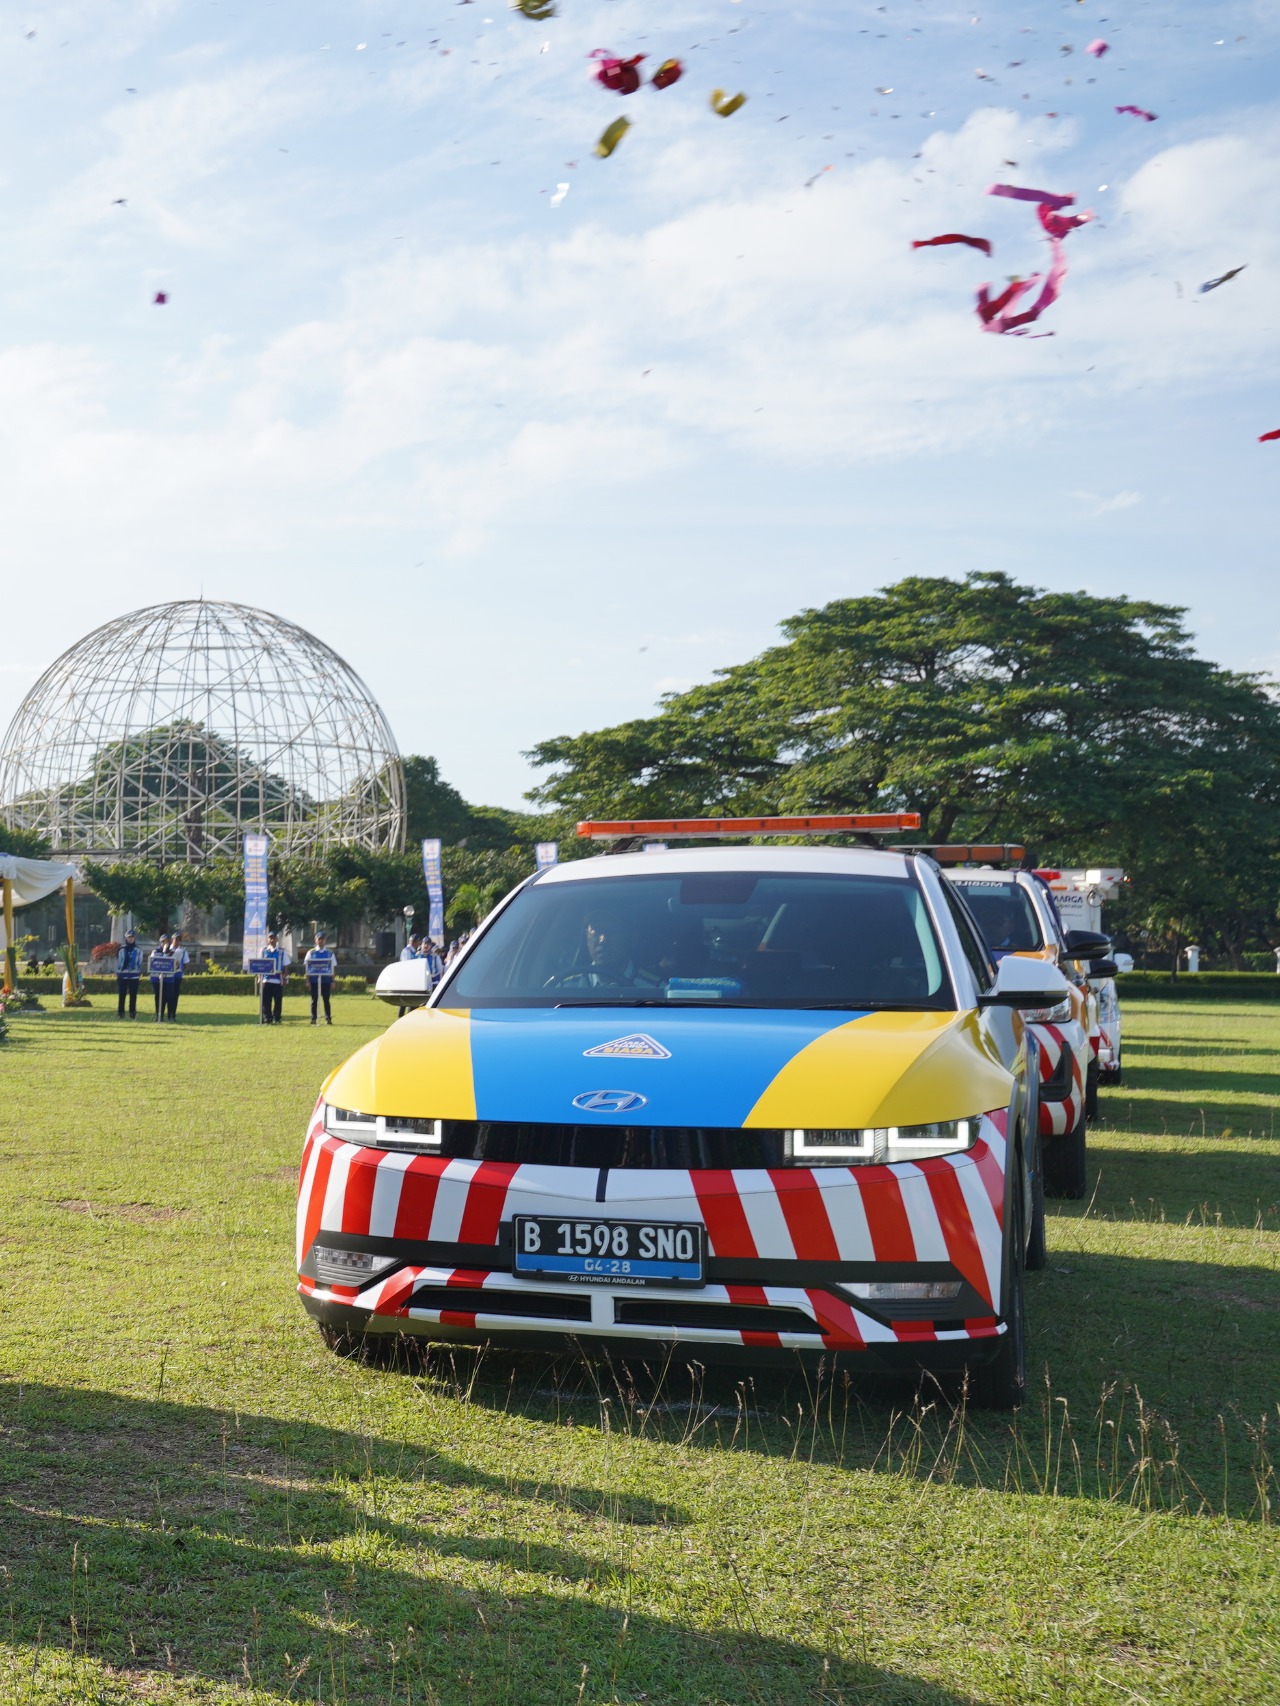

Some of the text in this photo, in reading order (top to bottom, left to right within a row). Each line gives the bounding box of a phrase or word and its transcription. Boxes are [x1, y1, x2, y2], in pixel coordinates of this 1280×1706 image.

[603, 1047, 654, 1055] SIAGA
[524, 1221, 693, 1260] B 1598 SNO
[580, 1275, 646, 1286] HYUNDAI ANDALAN
